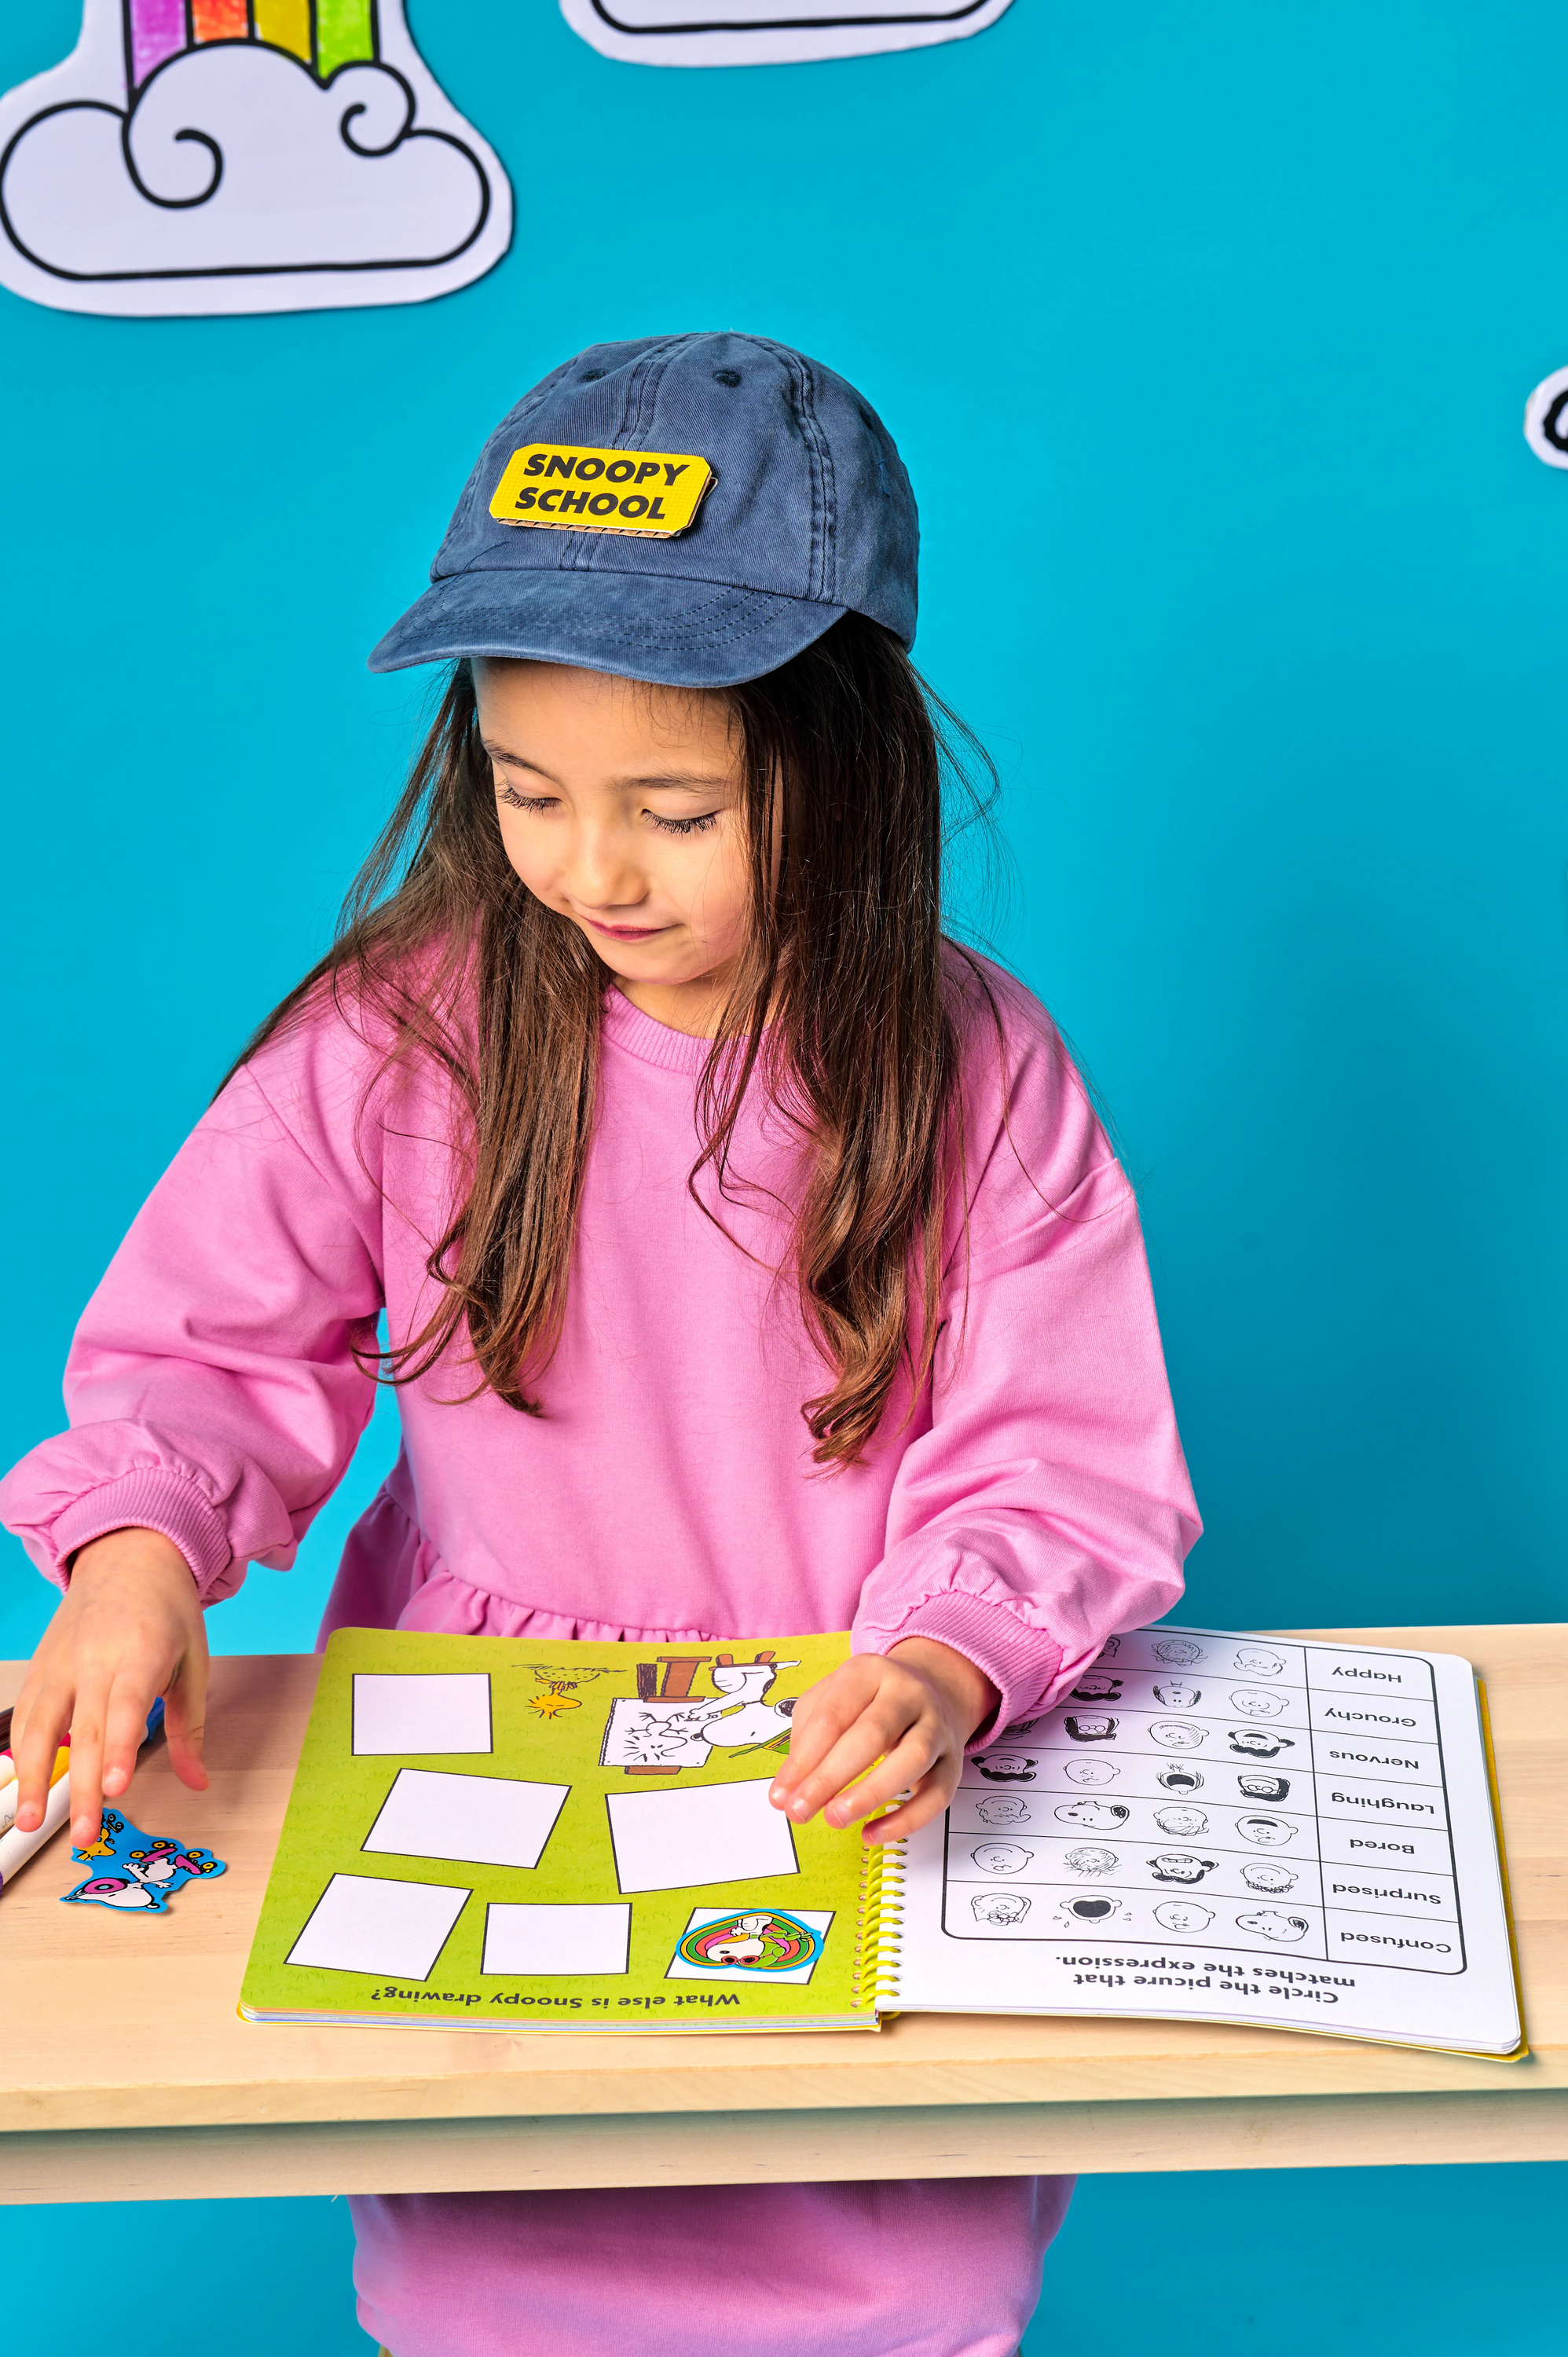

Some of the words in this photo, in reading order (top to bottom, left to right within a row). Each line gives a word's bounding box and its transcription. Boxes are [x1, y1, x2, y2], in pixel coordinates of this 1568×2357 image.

[523, 453, 690, 486] SNOOPY
[515, 487, 665, 520] SCHOOL
[1332, 1666, 1401, 1683] Happy
[1324, 1707, 1416, 1727] Grouchy
[1329, 1750, 1419, 1769] Nervous
[1332, 1792, 1434, 1814] Laughing
[1350, 1838, 1415, 1854] Bored
[1332, 1883, 1442, 1904] Surprised
[1340, 1932, 1452, 1953] Confused
[1055, 1956, 1196, 1970] expression.
[1203, 1963, 1245, 1978] the
[1073, 1974, 1126, 1988] that
[1133, 1975, 1211, 1990] picure
[1252, 1966, 1356, 1988] matches
[371, 1986, 482, 2007] drawing?
[1219, 1981, 1262, 1996] the
[1268, 1985, 1339, 2003] Circle
[489, 1992, 583, 2009] Snoopy
[591, 1998, 610, 2009] is
[617, 1994, 666, 2009] else
[673, 1993, 741, 2007] What
